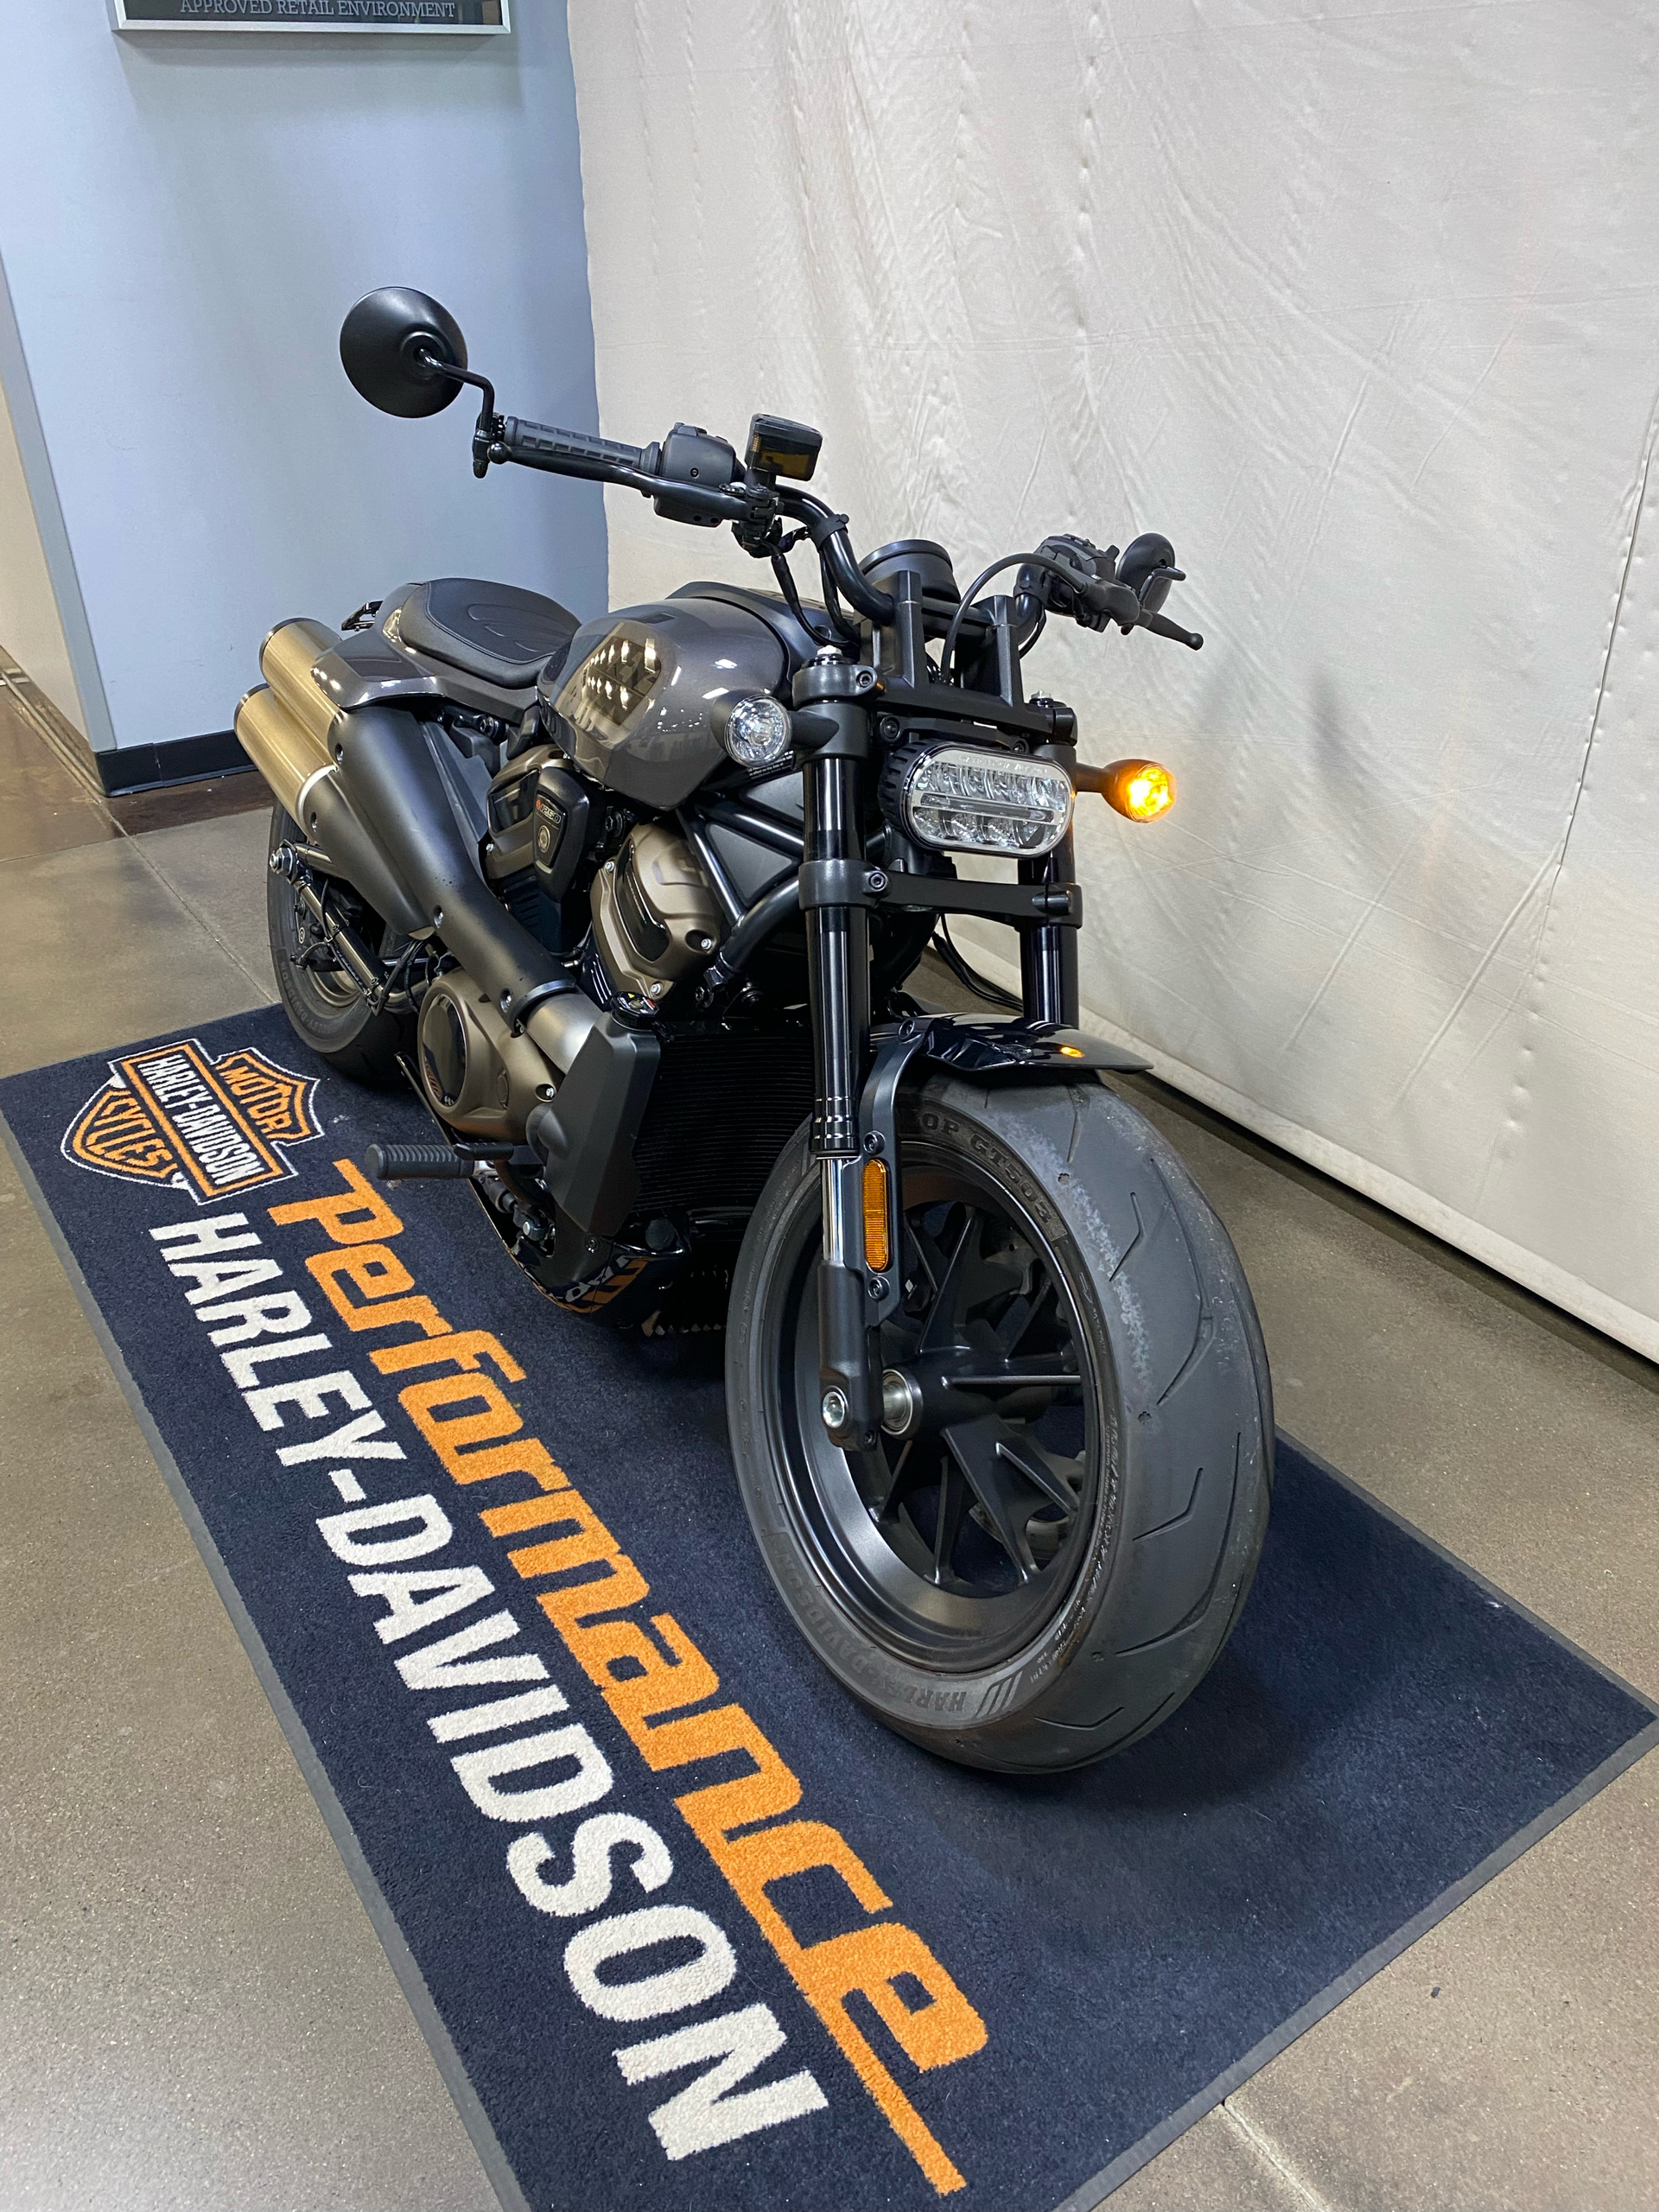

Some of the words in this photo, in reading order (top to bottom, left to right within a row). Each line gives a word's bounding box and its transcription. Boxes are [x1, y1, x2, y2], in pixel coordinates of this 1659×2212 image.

[181, 0, 272, 14] APPROVED
[277, 0, 334, 15] RETAIL
[338, 1, 455, 17] ENVIRONMENT
[86, 1096, 174, 1168] CYCLES
[137, 1054, 266, 1186] HARLEY-DAVIDSON
[220, 1064, 293, 1135] MOTOR
[149, 1211, 830, 2162] HARLEY-DAVIDSON
[268, 1159, 988, 2193] Performance
